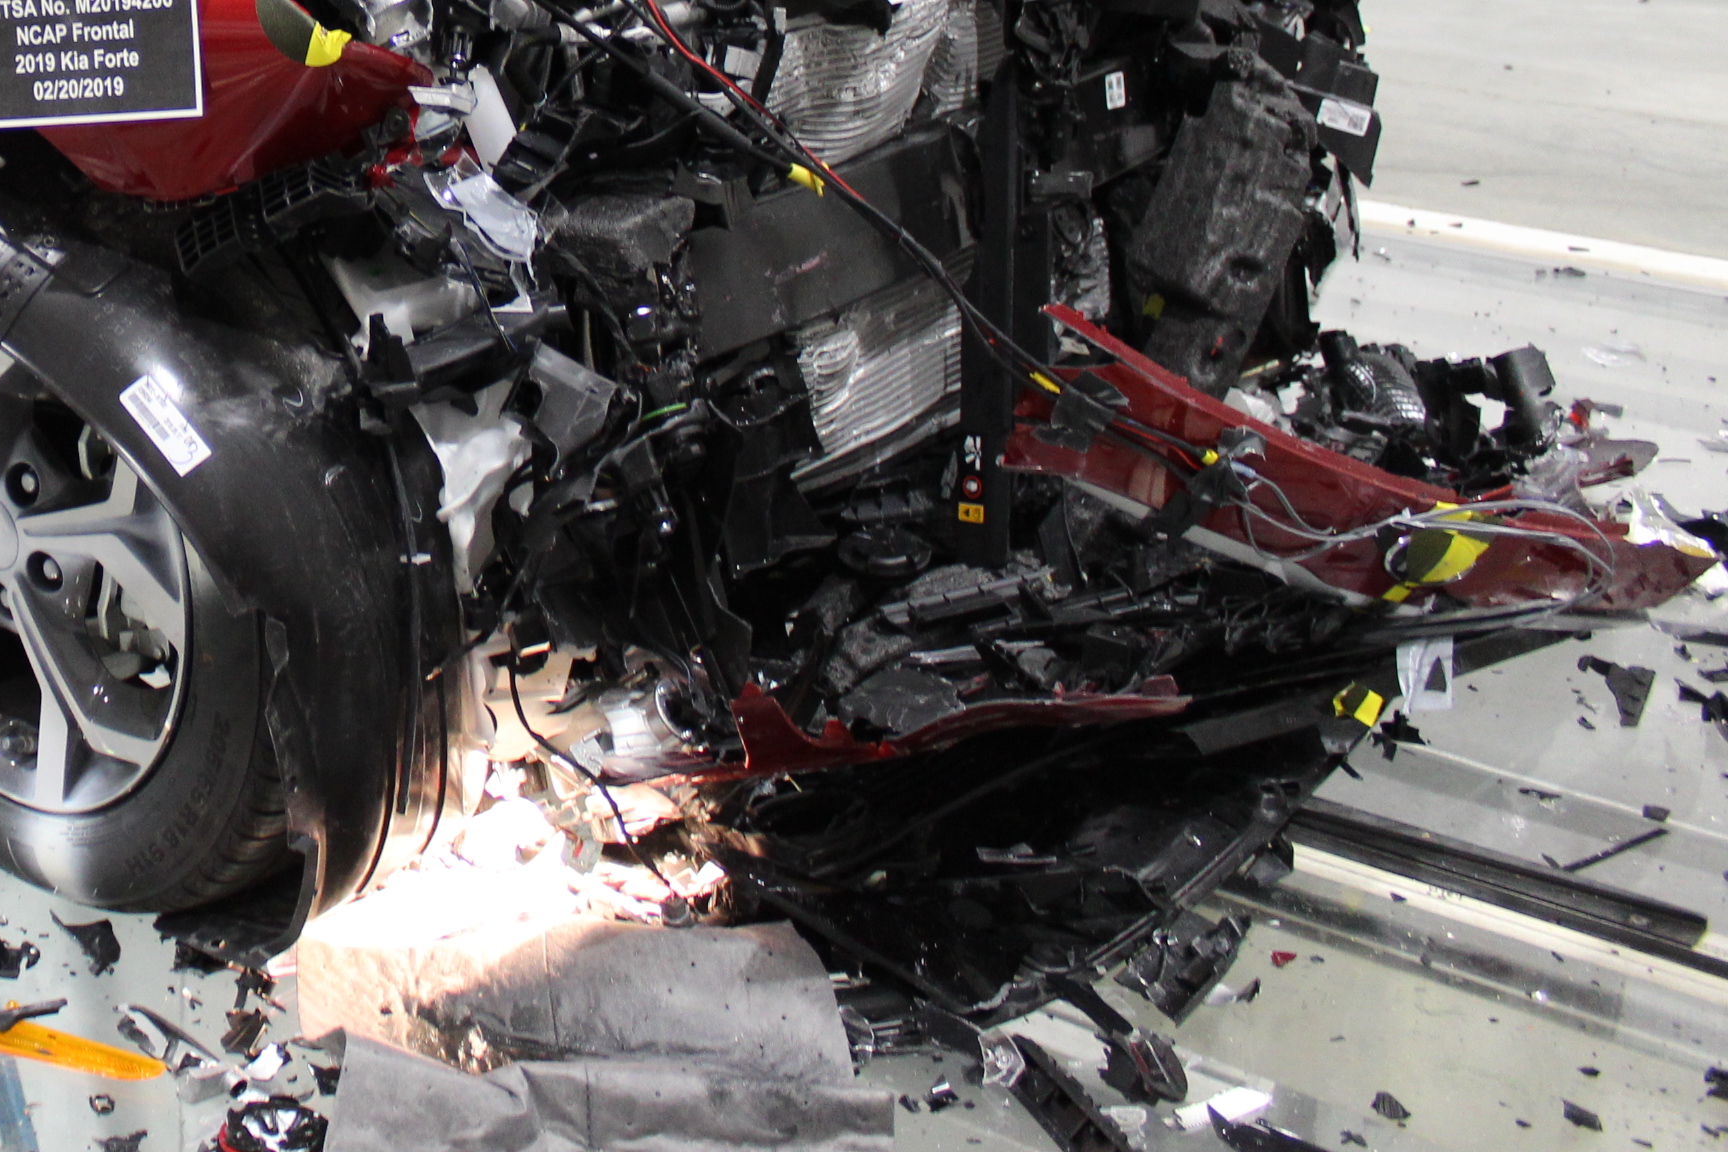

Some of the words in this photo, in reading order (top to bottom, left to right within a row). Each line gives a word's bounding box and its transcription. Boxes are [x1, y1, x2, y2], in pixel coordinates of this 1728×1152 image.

[16, 24, 68, 46] NCAP
[72, 18, 134, 42] Frontal
[15, 52, 56, 74] 2019
[60, 51, 89, 71] Kia
[93, 48, 139, 69] Forte
[33, 76, 124, 101] 02/20/2019
